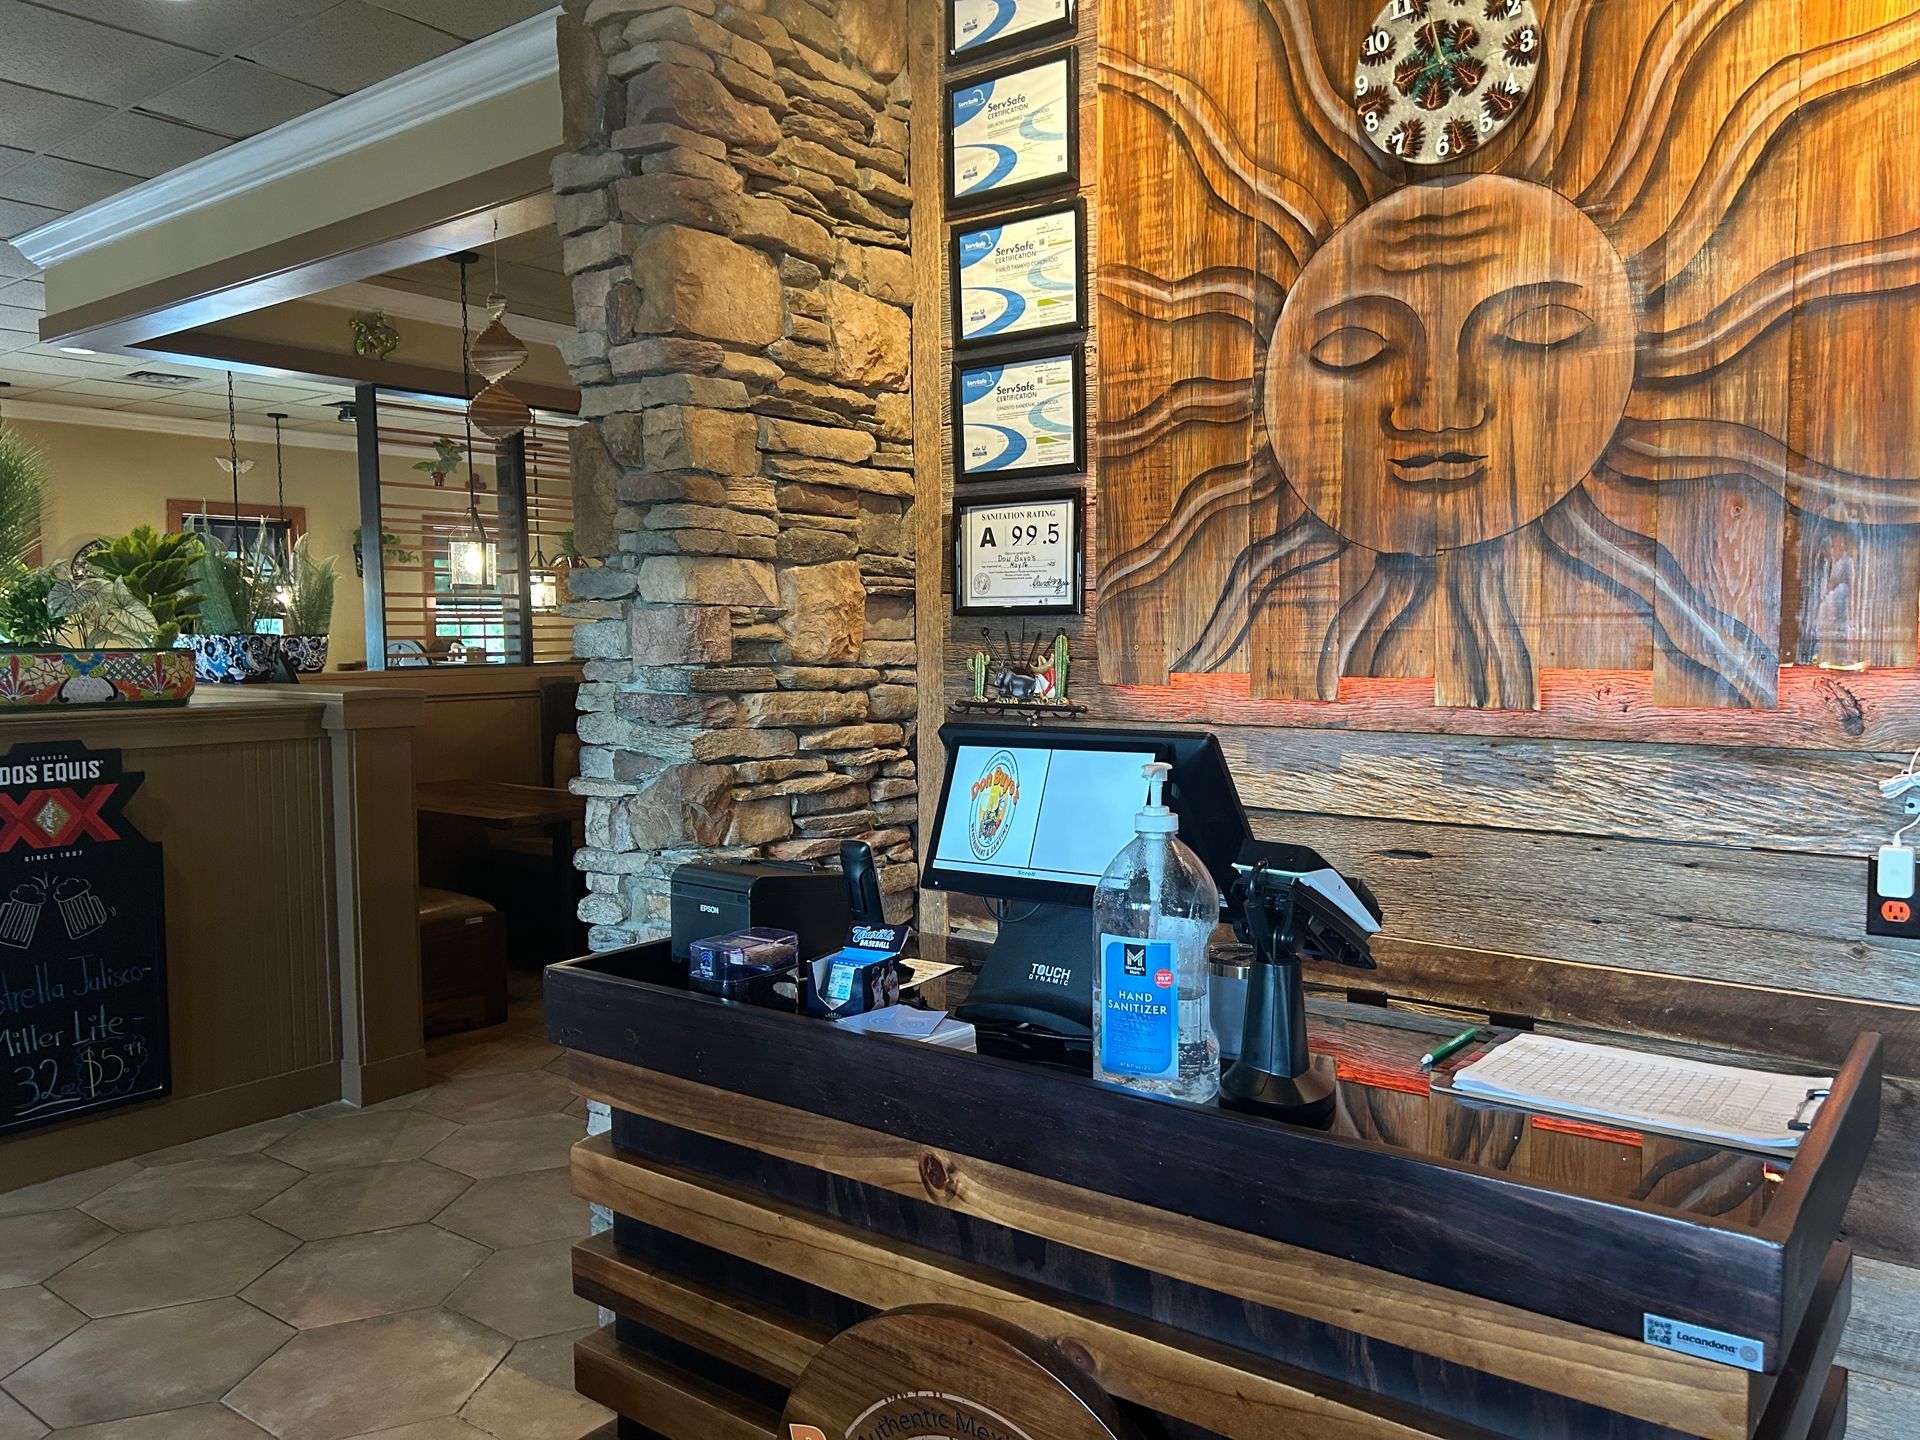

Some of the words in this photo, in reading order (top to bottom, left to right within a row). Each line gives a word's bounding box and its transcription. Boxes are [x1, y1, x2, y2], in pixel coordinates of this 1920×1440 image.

[1365, 31, 1390, 56] 10
[1520, 29, 1534, 53] 3
[1355, 75, 1369, 96] 9
[1505, 72, 1521, 95] 4
[987, 93, 1026, 113] ServSafe
[987, 103, 1029, 120] CERTIFICATION
[1364, 111, 1379, 132] 8
[1479, 110, 1493, 133] 5
[1391, 132, 1405, 155] 7
[1435, 134, 1450, 156] 6
[995, 241, 1034, 257] ServSafe
[995, 251, 1037, 264] CERTIFICATION
[996, 391, 1037, 403] CERTIFICATION
[997, 381, 1035, 395] ServSafe
[981, 512, 1025, 521] SANITATION
[1026, 510, 1056, 519] RATING
[980, 526, 997, 548] A
[30, 754, 69, 762] CERVEZA
[0, 765, 38, 786] DOS
[42, 760, 101, 782] EQUIS
[24, 853, 55, 862] SINCE
[700, 904, 719, 914] EPSON
[859, 939, 890, 949] BASEBALL
[1028, 973, 1069, 986] DYNAMIC
[1031, 963, 1072, 981] TOUCH
[1118, 990, 1154, 1003] HAND
[1107, 999, 1168, 1015] SANITIZER
[1676, 1331, 1736, 1354] Lacandona
[857, 1407, 949, 1440] uthentic
